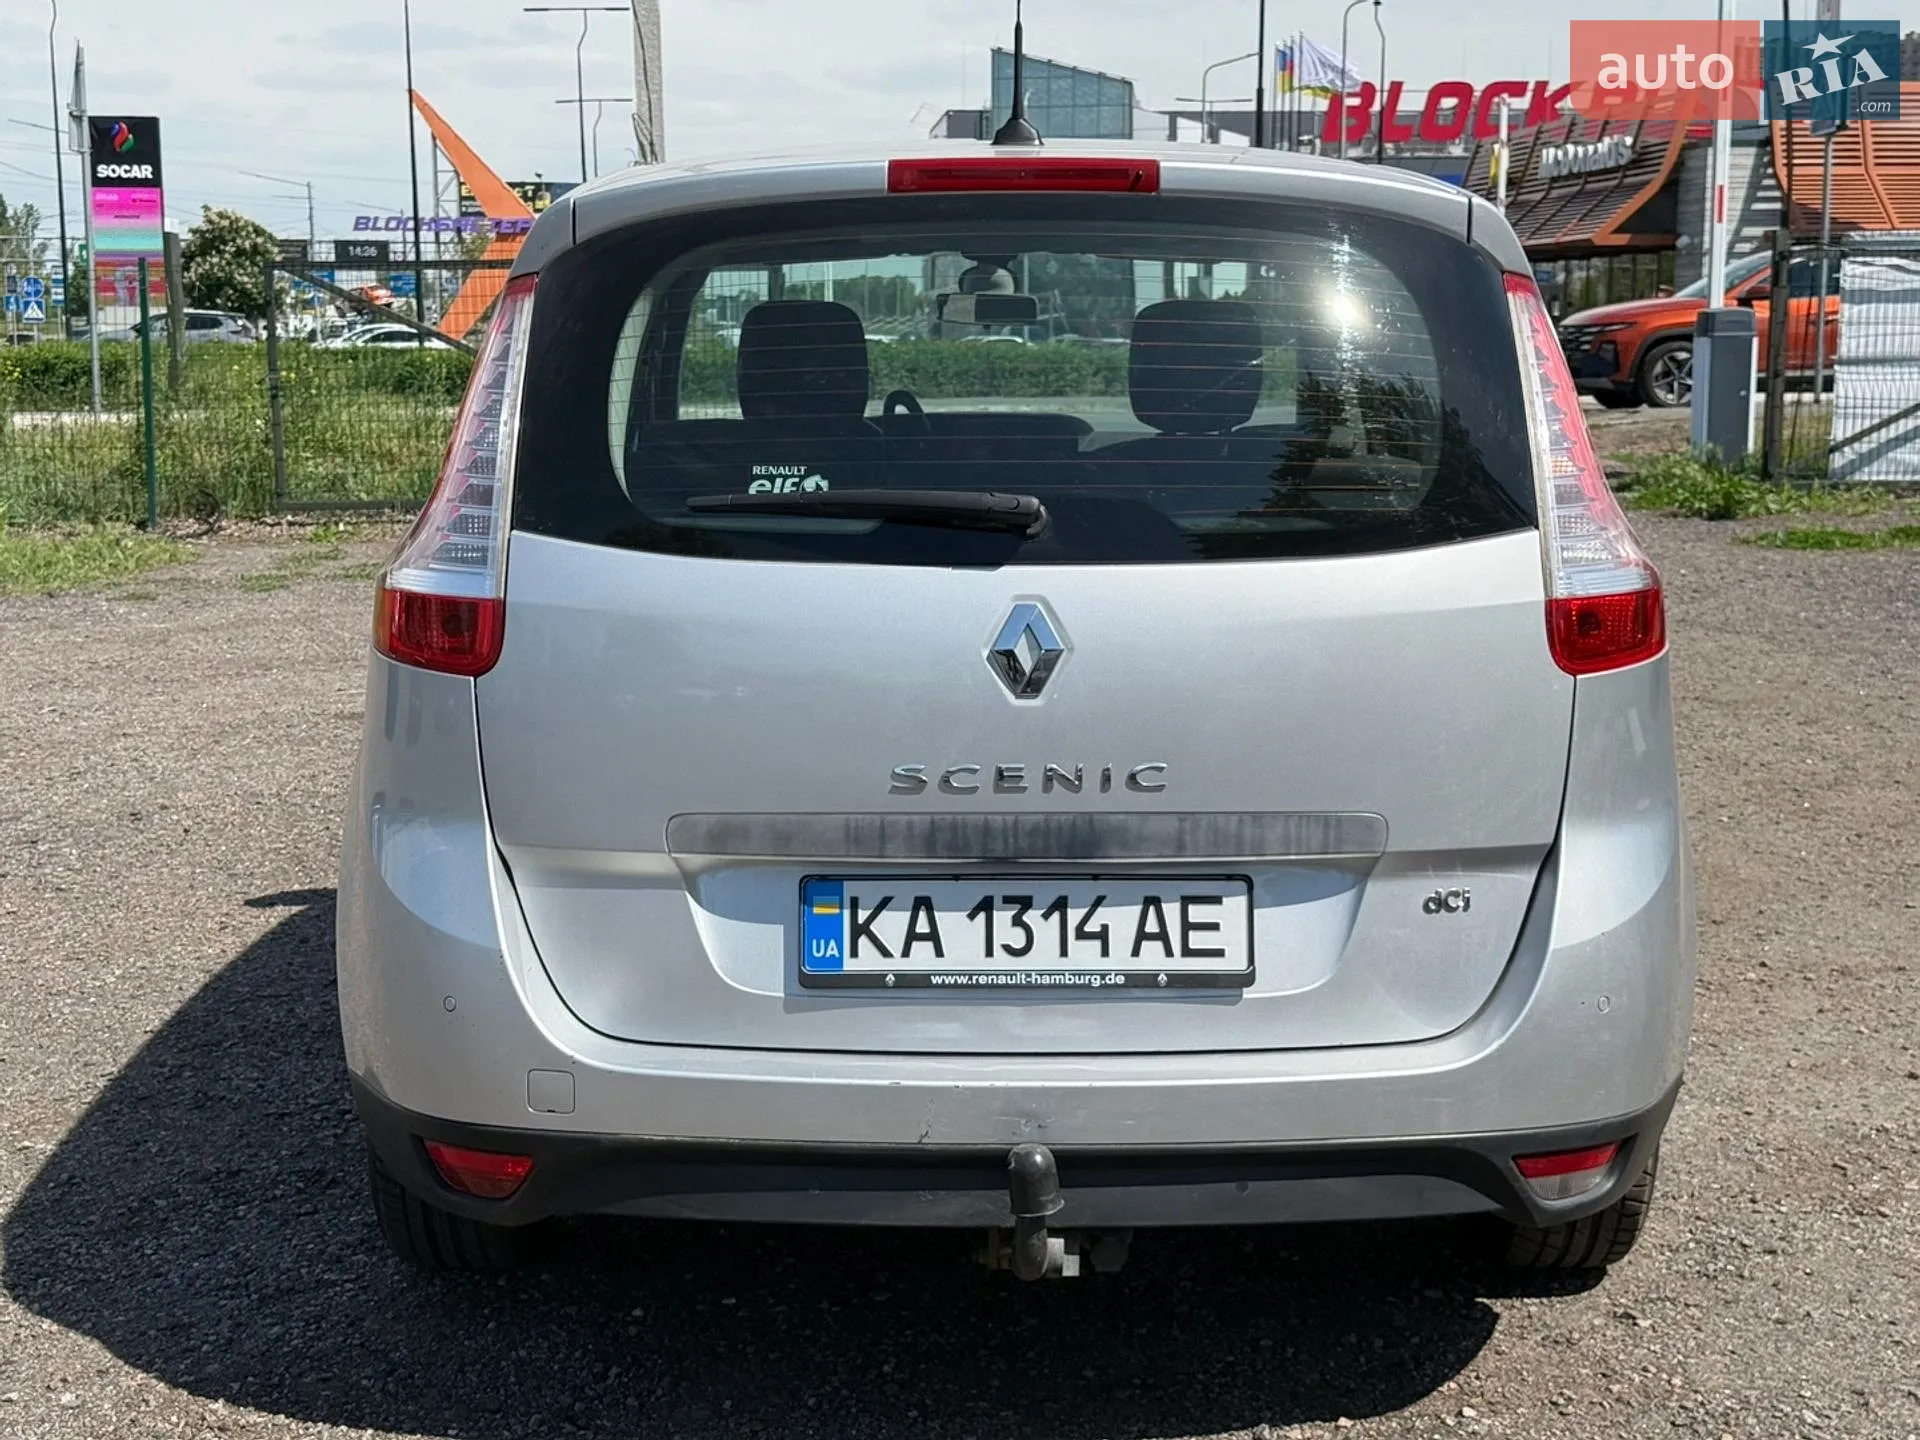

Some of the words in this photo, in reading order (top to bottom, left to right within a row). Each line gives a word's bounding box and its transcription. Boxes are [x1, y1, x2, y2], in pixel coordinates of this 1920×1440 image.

[96, 164, 153, 179] SOCAR
[752, 466, 807, 475] RENAULT
[748, 477, 800, 495] elf
[888, 761, 1168, 795] SCENIC
[1422, 887, 1471, 915] dCi
[849, 895, 945, 959] KA
[966, 895, 1110, 959] 1314
[1130, 895, 1226, 959] AE
[812, 939, 840, 958] UA
[930, 972, 1126, 987] www.renault-hamburg.de
